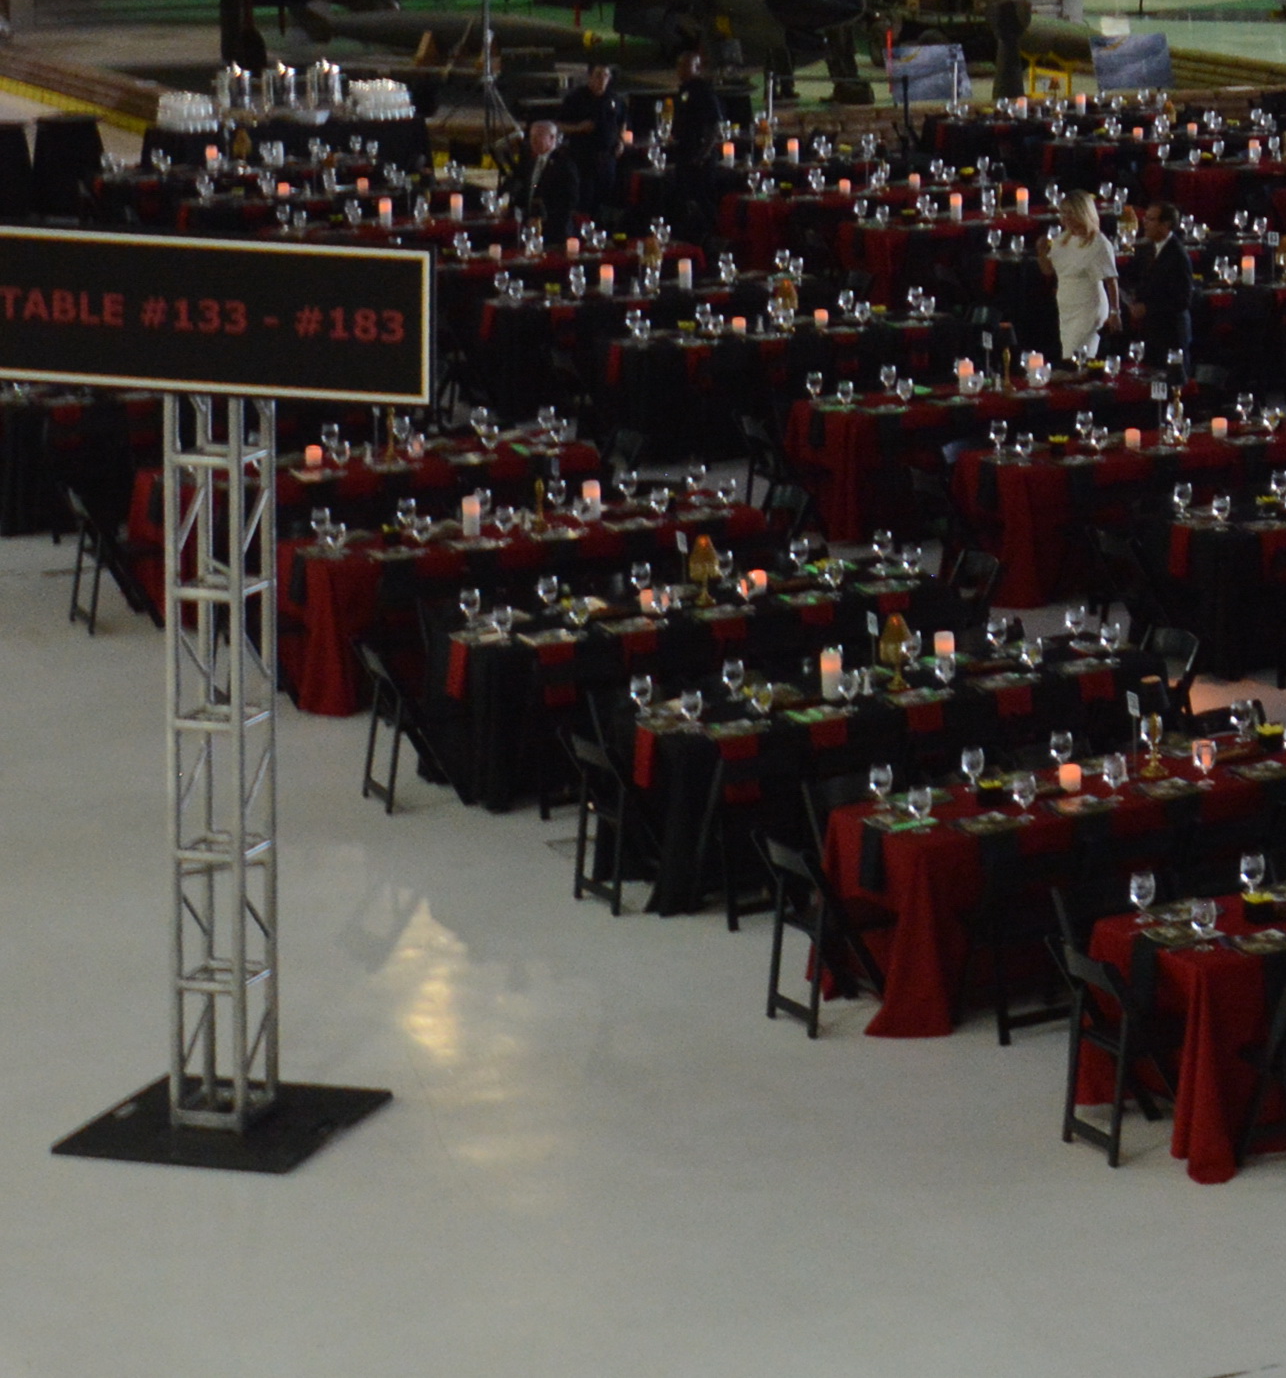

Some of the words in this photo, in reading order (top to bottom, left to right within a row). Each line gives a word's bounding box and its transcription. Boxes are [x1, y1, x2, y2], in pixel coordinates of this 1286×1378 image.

[0, 285, 126, 328] TABLE
[140, 295, 249, 336] #133
[293, 305, 406, 344] #183
